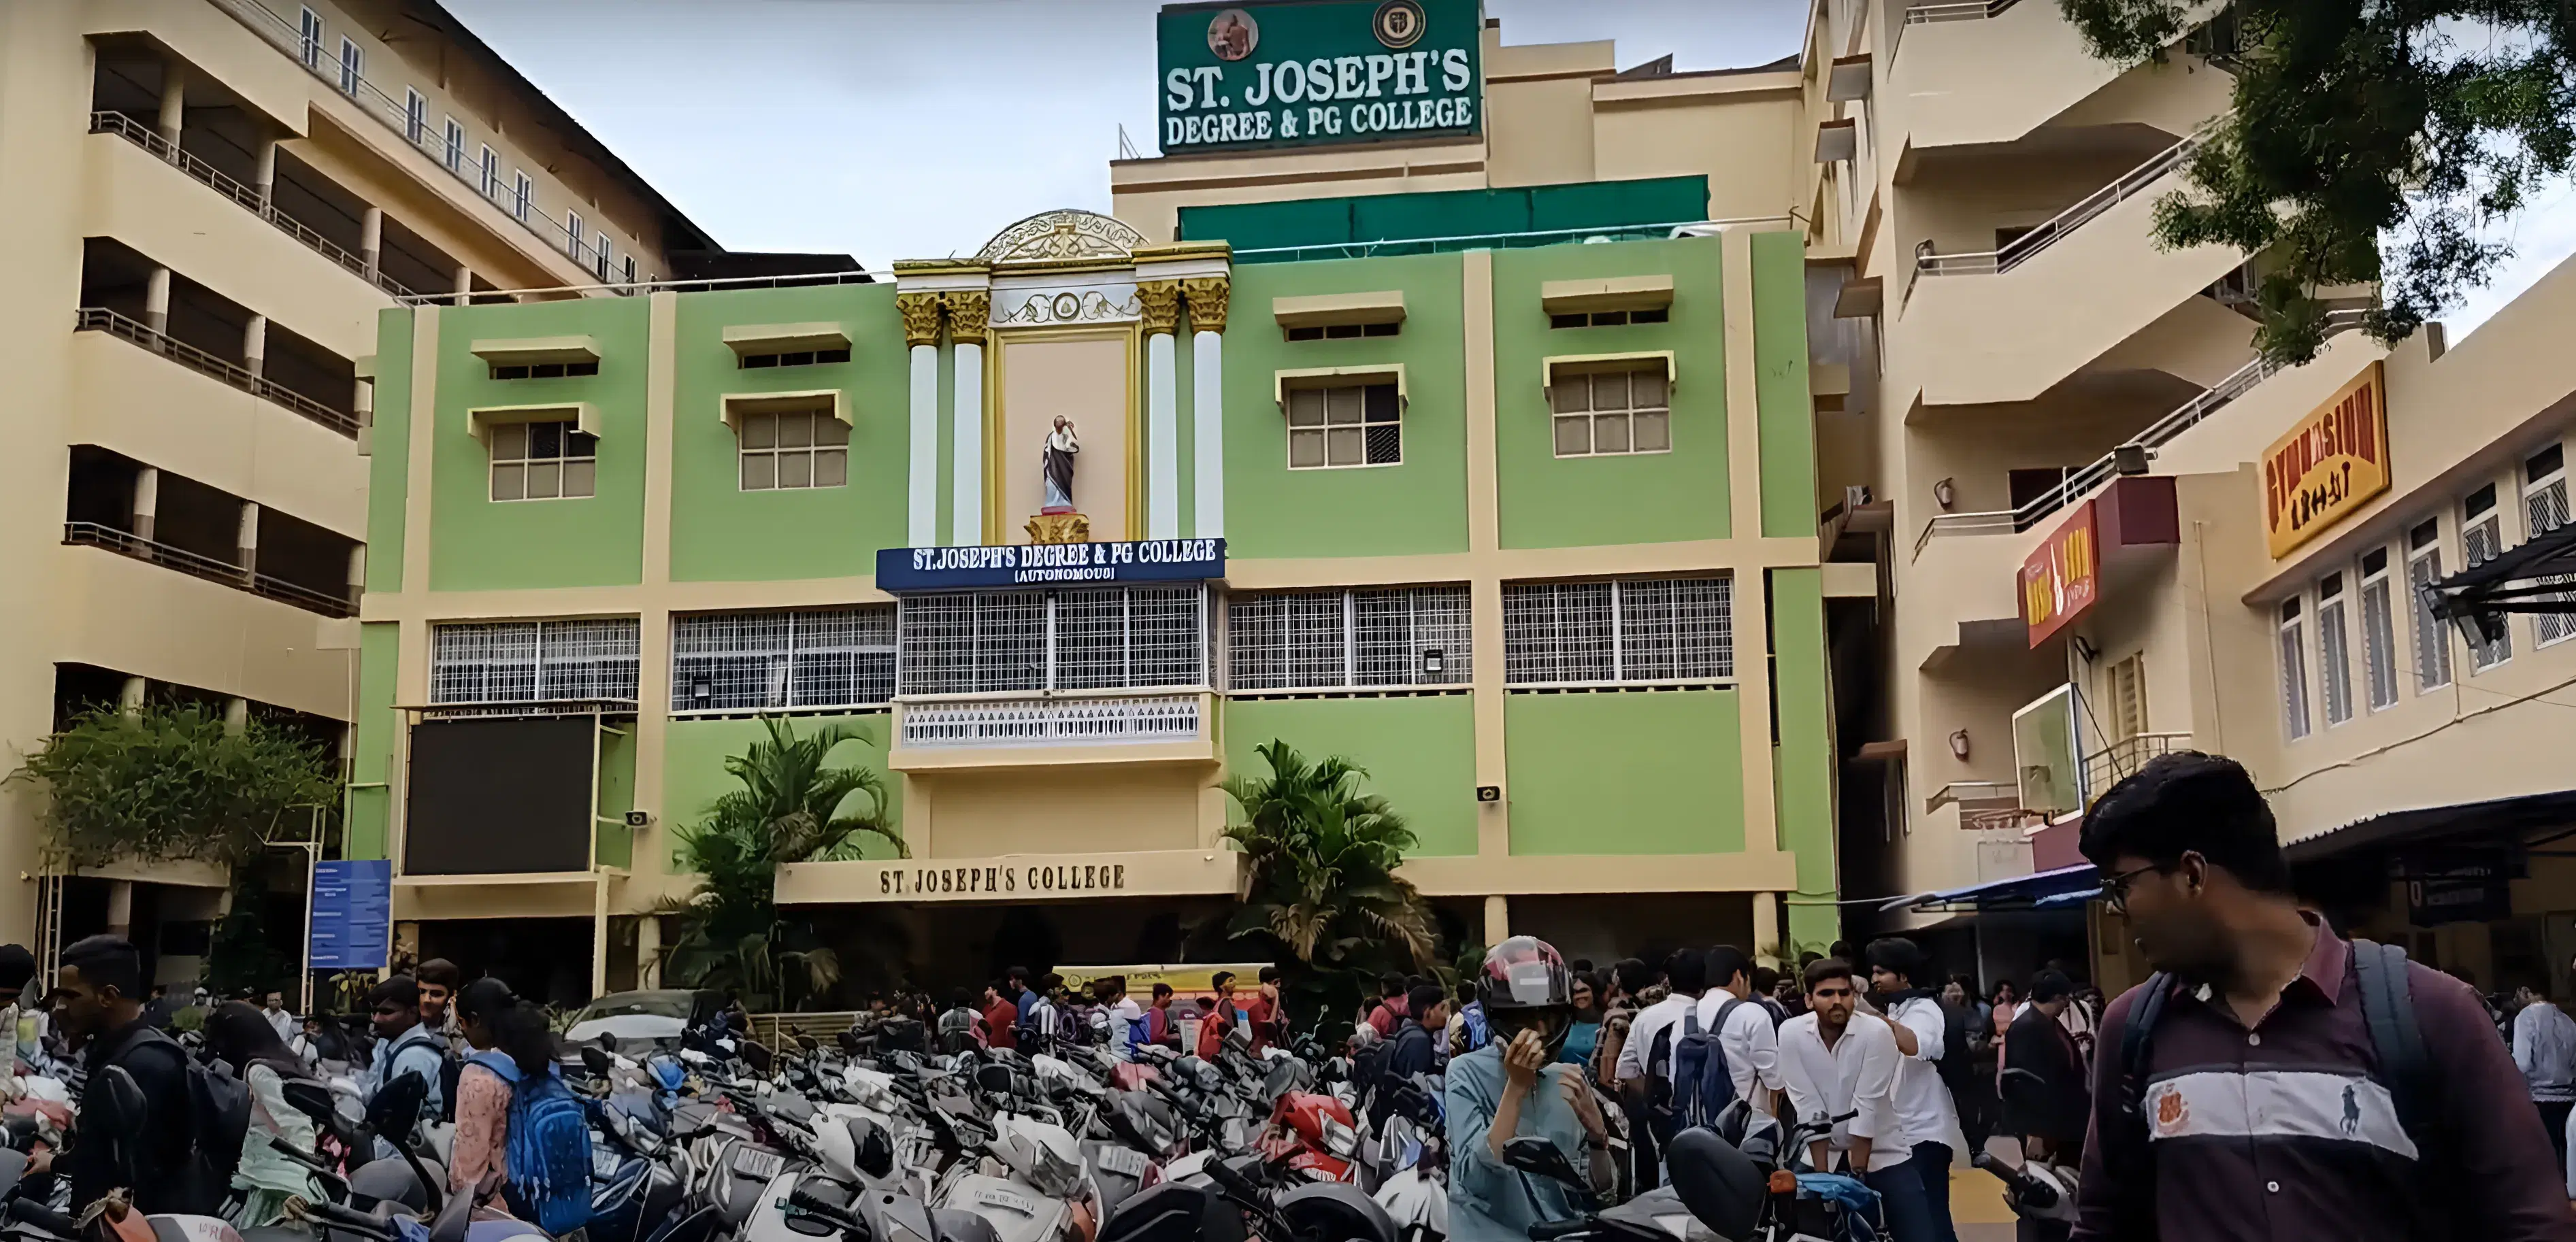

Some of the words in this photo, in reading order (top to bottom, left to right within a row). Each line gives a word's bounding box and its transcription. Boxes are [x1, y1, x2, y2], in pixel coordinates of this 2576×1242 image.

[1167, 67, 1229, 112] ST.
[1245, 48, 1471, 107] JOSEPH'S
[1167, 112, 1272, 146] DEGREE
[1281, 107, 1300, 138] &
[1307, 106, 1343, 135] PG
[1350, 97, 1473, 131] COLLEGE
[1021, 543, 1089, 567] DEGREE
[1094, 543, 1106, 565] &
[1111, 543, 1133, 564] PG
[1138, 539, 1216, 563] COLLEGE
[1027, 864, 1124, 891] COLLEGE
